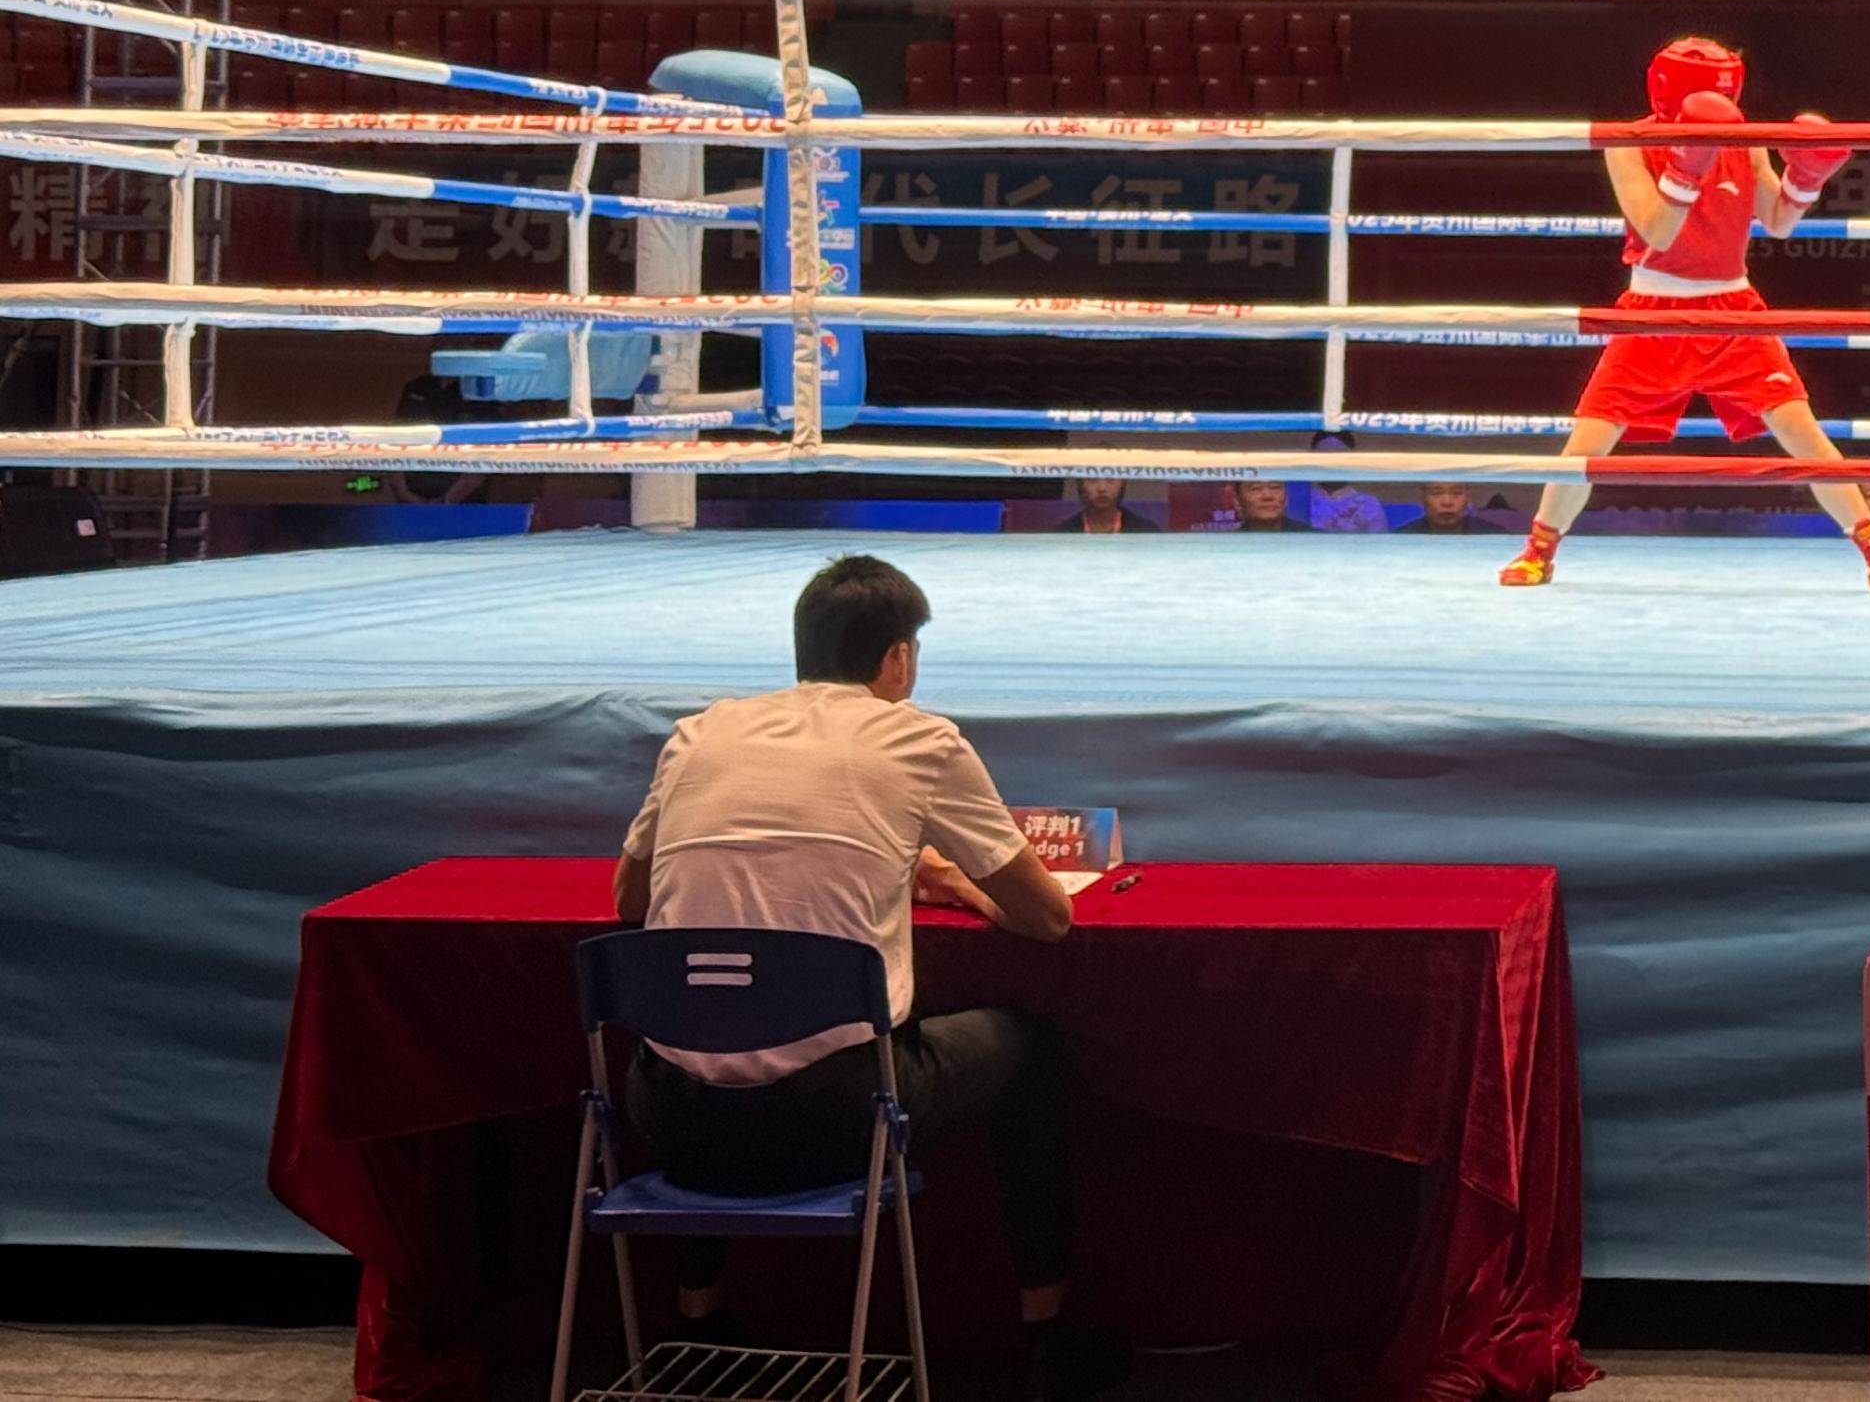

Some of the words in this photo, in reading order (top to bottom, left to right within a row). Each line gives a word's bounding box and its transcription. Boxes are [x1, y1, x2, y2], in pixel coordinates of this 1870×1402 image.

[1025, 815, 1082, 837] 评判1
[1032, 840, 1071, 860] dge
[1075, 840, 1085, 856] 1
